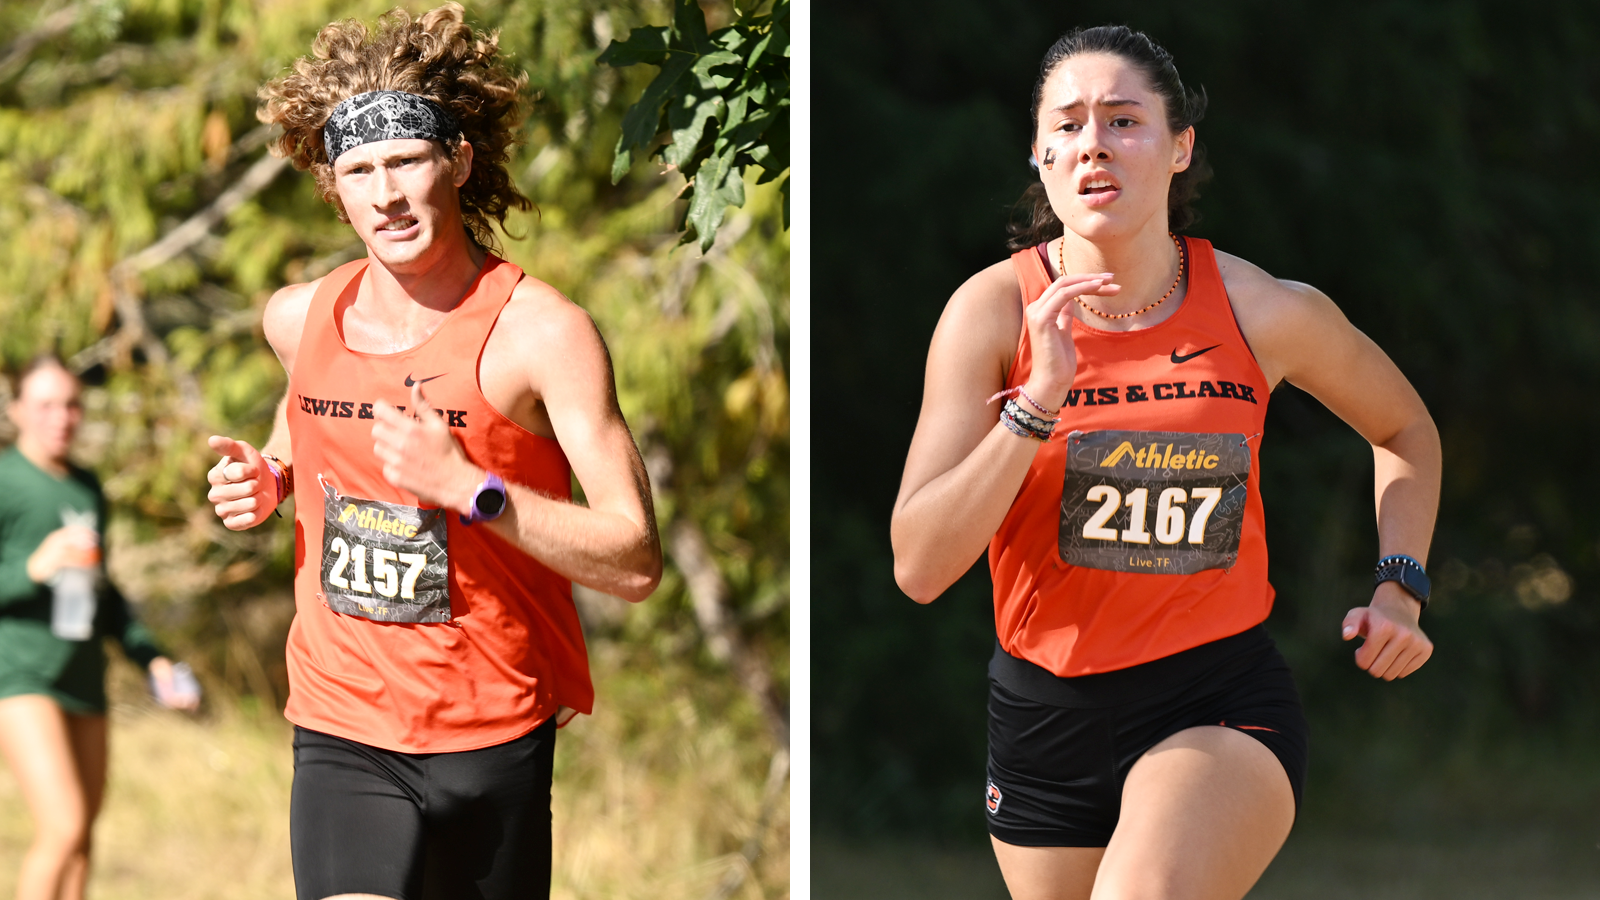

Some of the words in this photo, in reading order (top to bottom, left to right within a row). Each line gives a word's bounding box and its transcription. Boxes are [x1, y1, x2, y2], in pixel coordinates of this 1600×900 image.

[297, 394, 355, 418] LEWIS
[358, 403, 374, 419] &
[1062, 387, 1119, 407] WIS
[1126, 384, 1149, 403] &
[1153, 380, 1257, 404] CLARK
[1100, 440, 1220, 471] Athletic
[338, 503, 418, 538] Athletic
[1082, 485, 1222, 546] 2167
[329, 536, 427, 600] 2157
[1129, 557, 1170, 568] Live.TF
